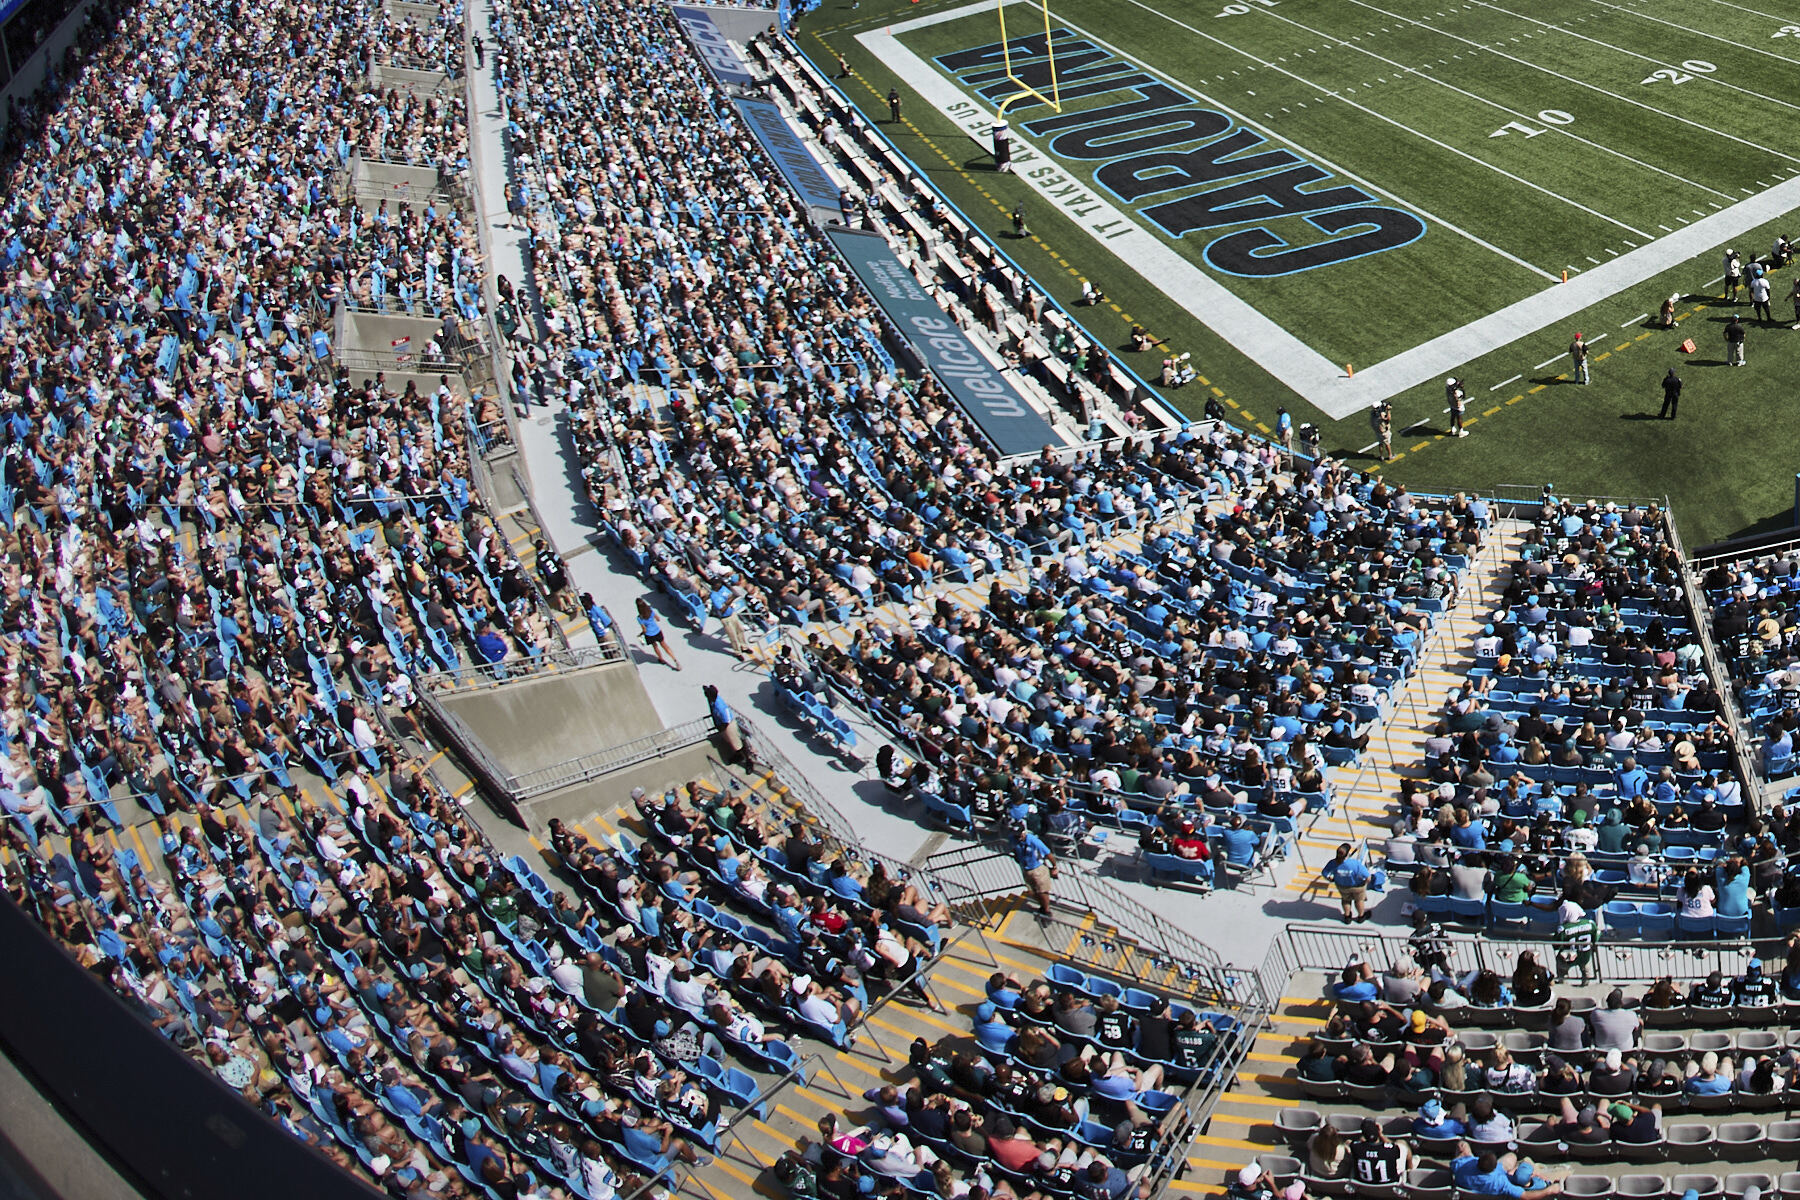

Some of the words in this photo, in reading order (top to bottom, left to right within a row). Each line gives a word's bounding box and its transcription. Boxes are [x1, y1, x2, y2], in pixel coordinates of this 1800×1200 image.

[688, 16, 751, 75] GEICO
[1652, 59, 1718, 85] 20
[946, 101, 980, 120] US
[1500, 109, 1576, 140] 10
[932, 28, 1428, 279] CAROLINA
[1026, 166, 1103, 218] TAKES
[1091, 220, 1134, 240] IT
[866, 260, 906, 299] Medicare
[911, 314, 1027, 418] wellcare
[1380, 657, 1393, 668] 55
[1275, 777, 1286, 789] 59
[1687, 898, 1702, 909] 88
[1183, 1049, 1197, 1068] 5
[1366, 1150, 1378, 1158] COX
[1357, 1159, 1390, 1183] 91
